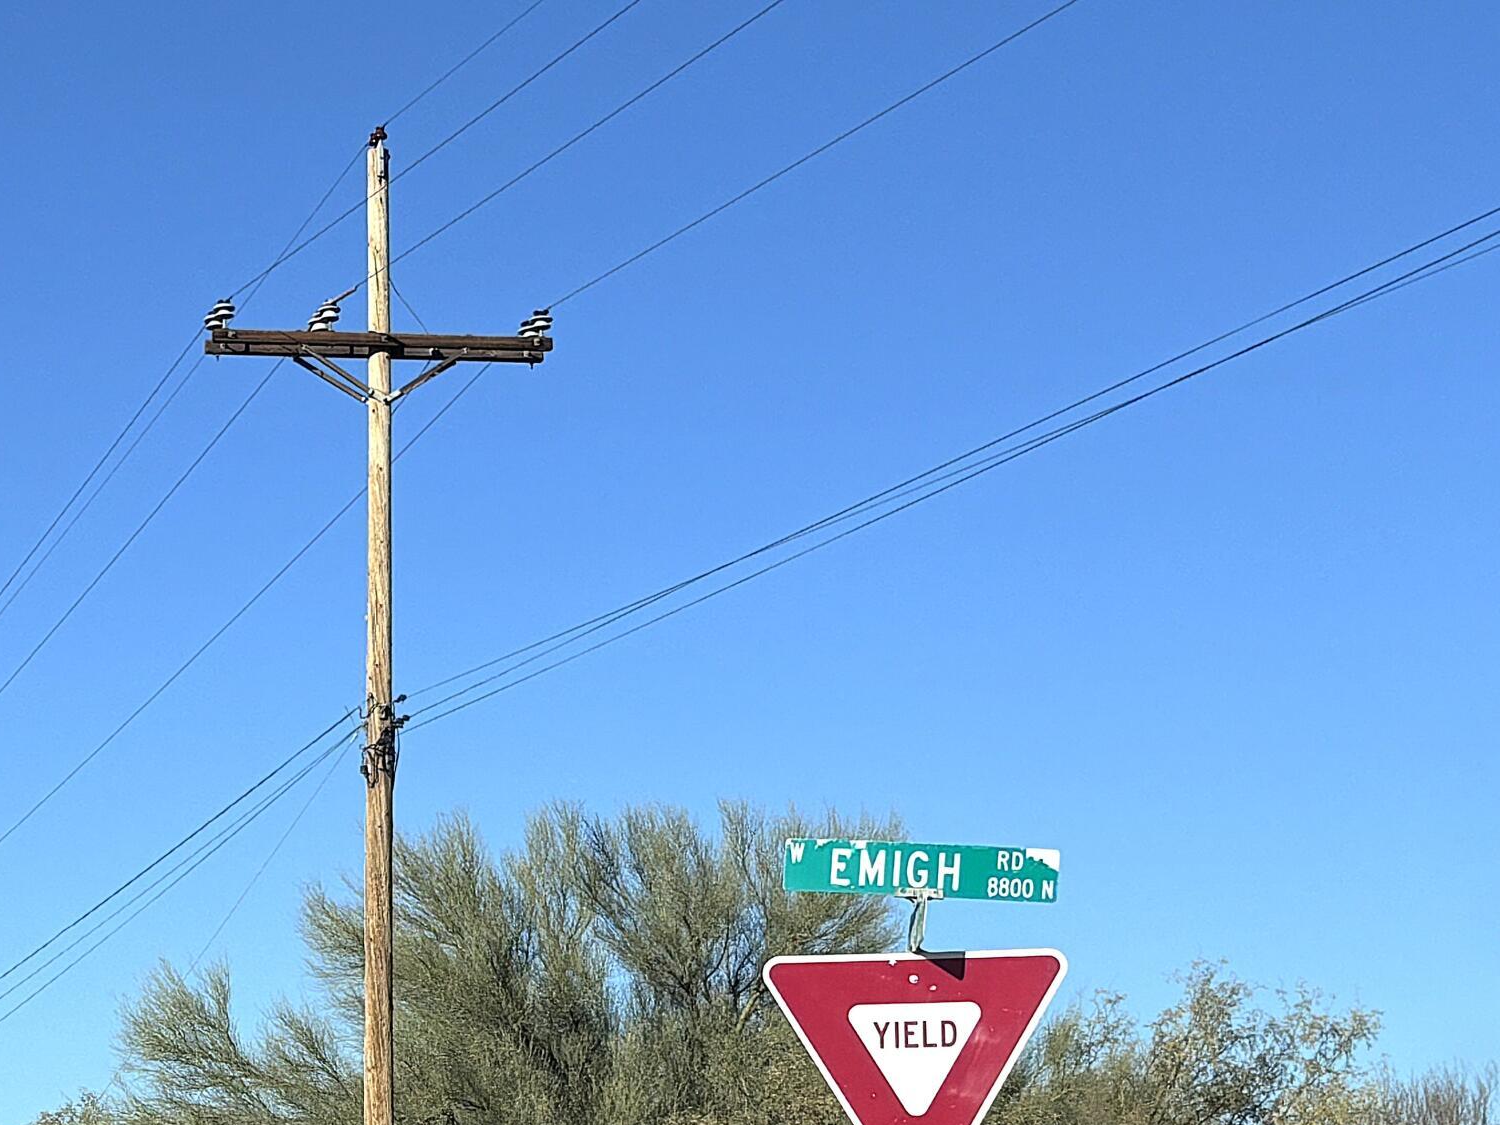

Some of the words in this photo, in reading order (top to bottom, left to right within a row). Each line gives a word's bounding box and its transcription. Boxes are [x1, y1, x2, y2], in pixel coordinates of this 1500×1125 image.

[790, 842, 805, 864] W
[830, 848, 961, 892] EMIGH
[997, 850, 1024, 872] RD
[987, 877, 1034, 899] 8800
[1041, 880, 1054, 900] N
[873, 1020, 957, 1049] YIELD
